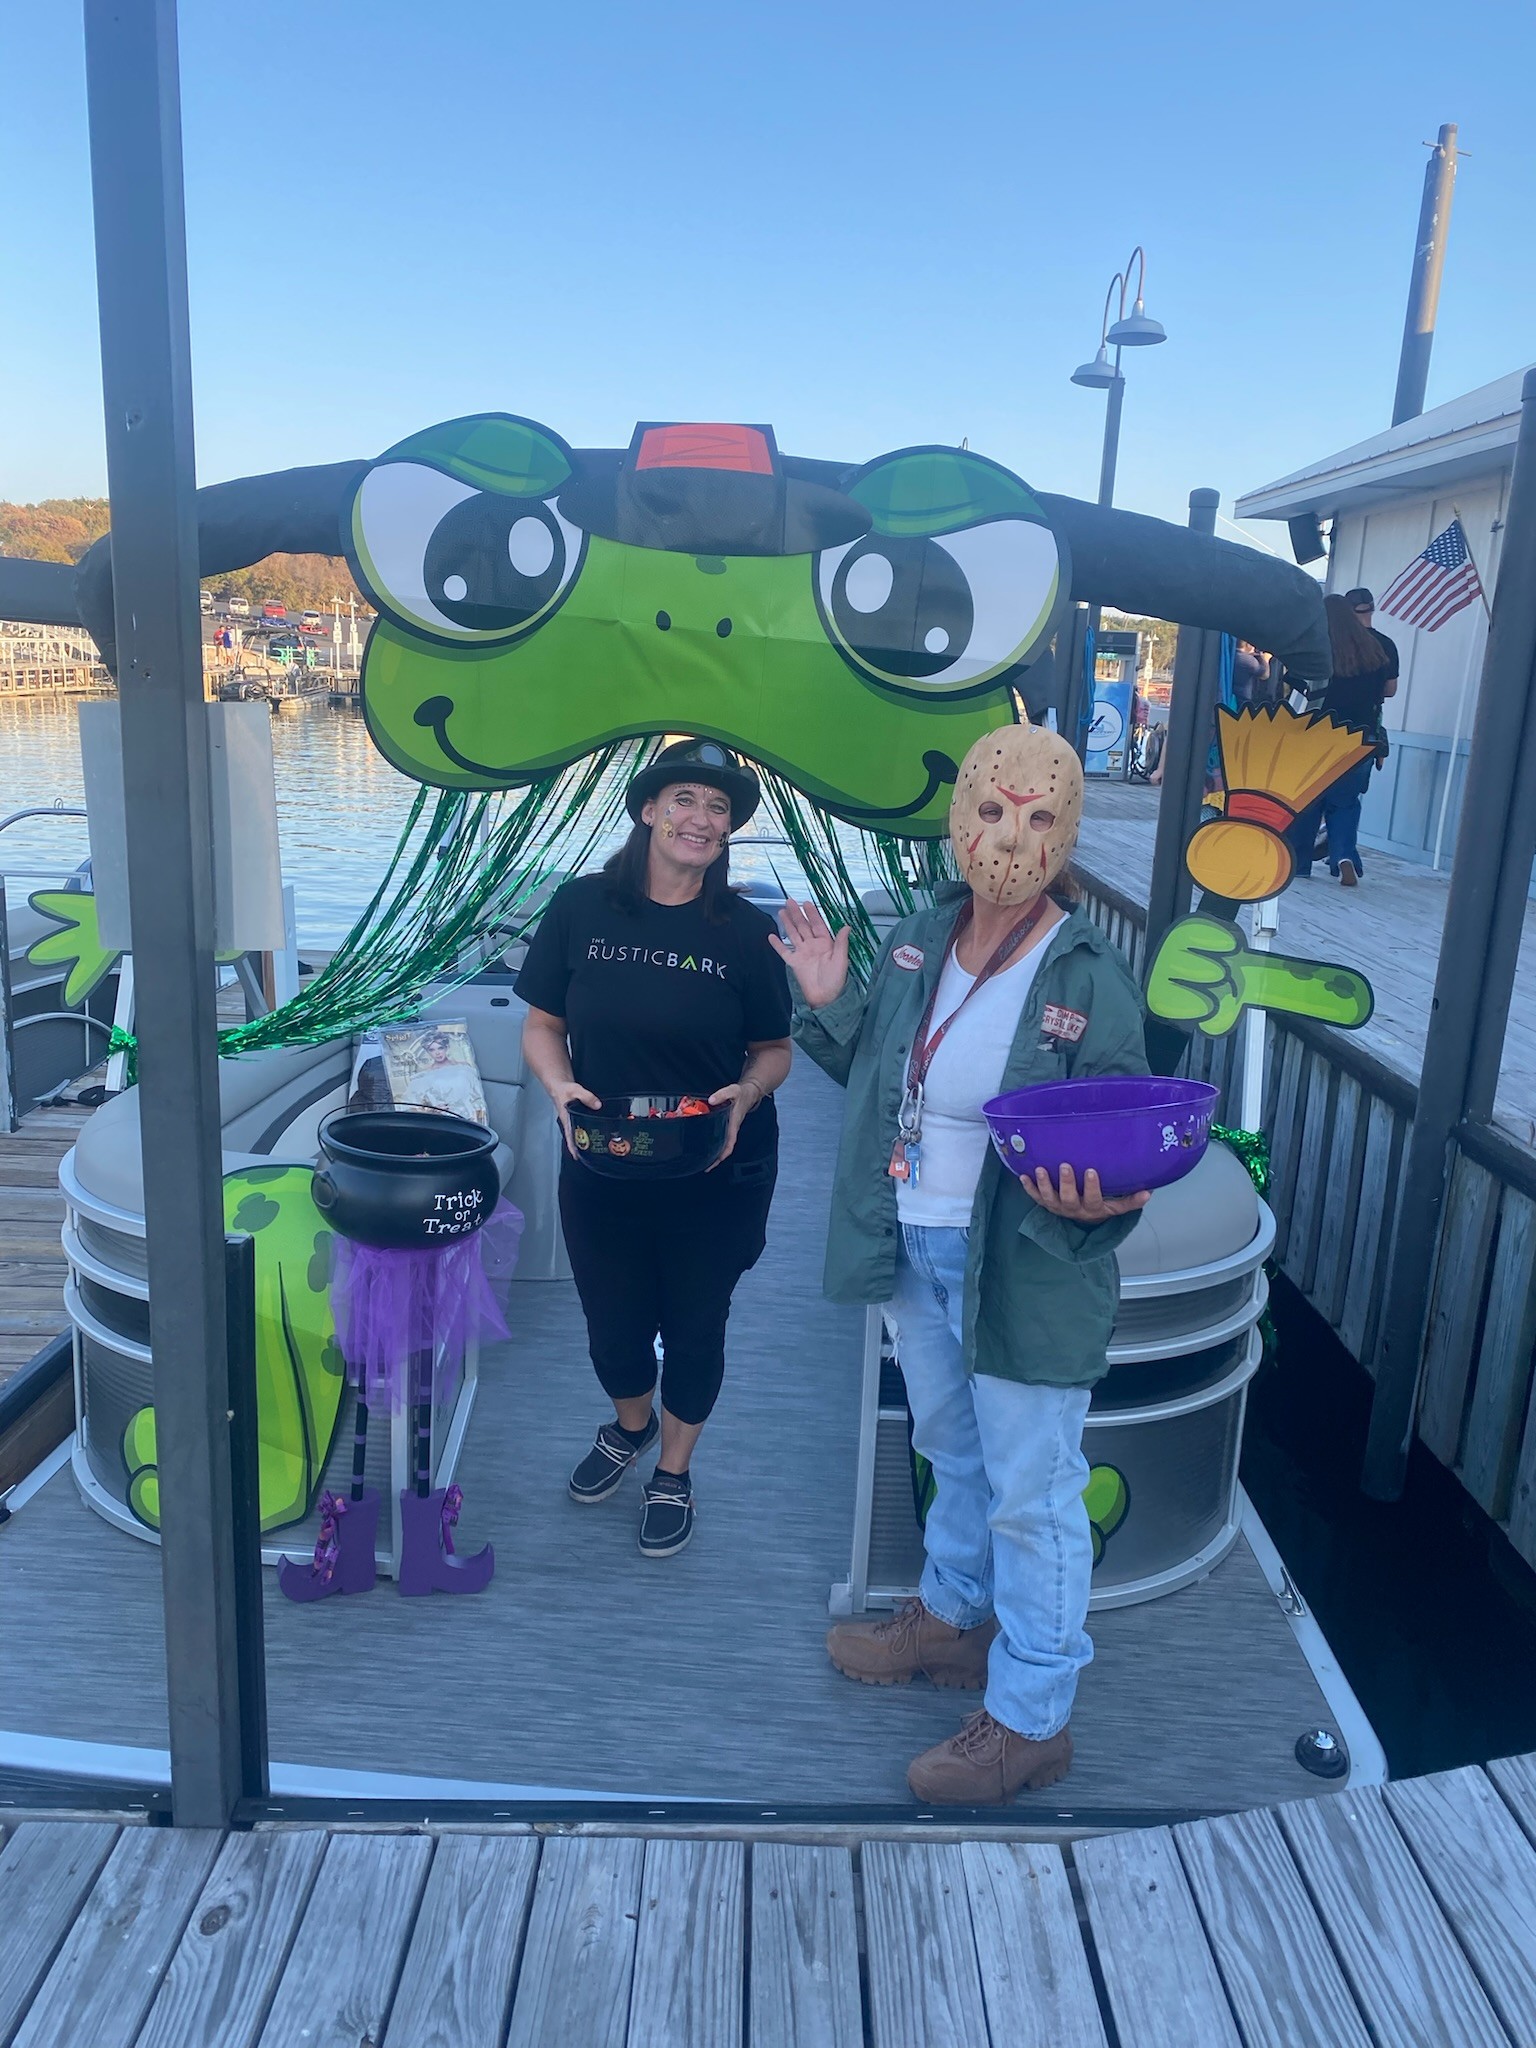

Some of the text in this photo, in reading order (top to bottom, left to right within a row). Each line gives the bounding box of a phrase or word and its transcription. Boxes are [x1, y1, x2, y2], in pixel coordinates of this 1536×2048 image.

[1042, 1014, 1066, 1030] RYSTL
[434, 1188, 483, 1210] Trick
[423, 1213, 483, 1234] Treat
[454, 1209, 470, 1221] or
